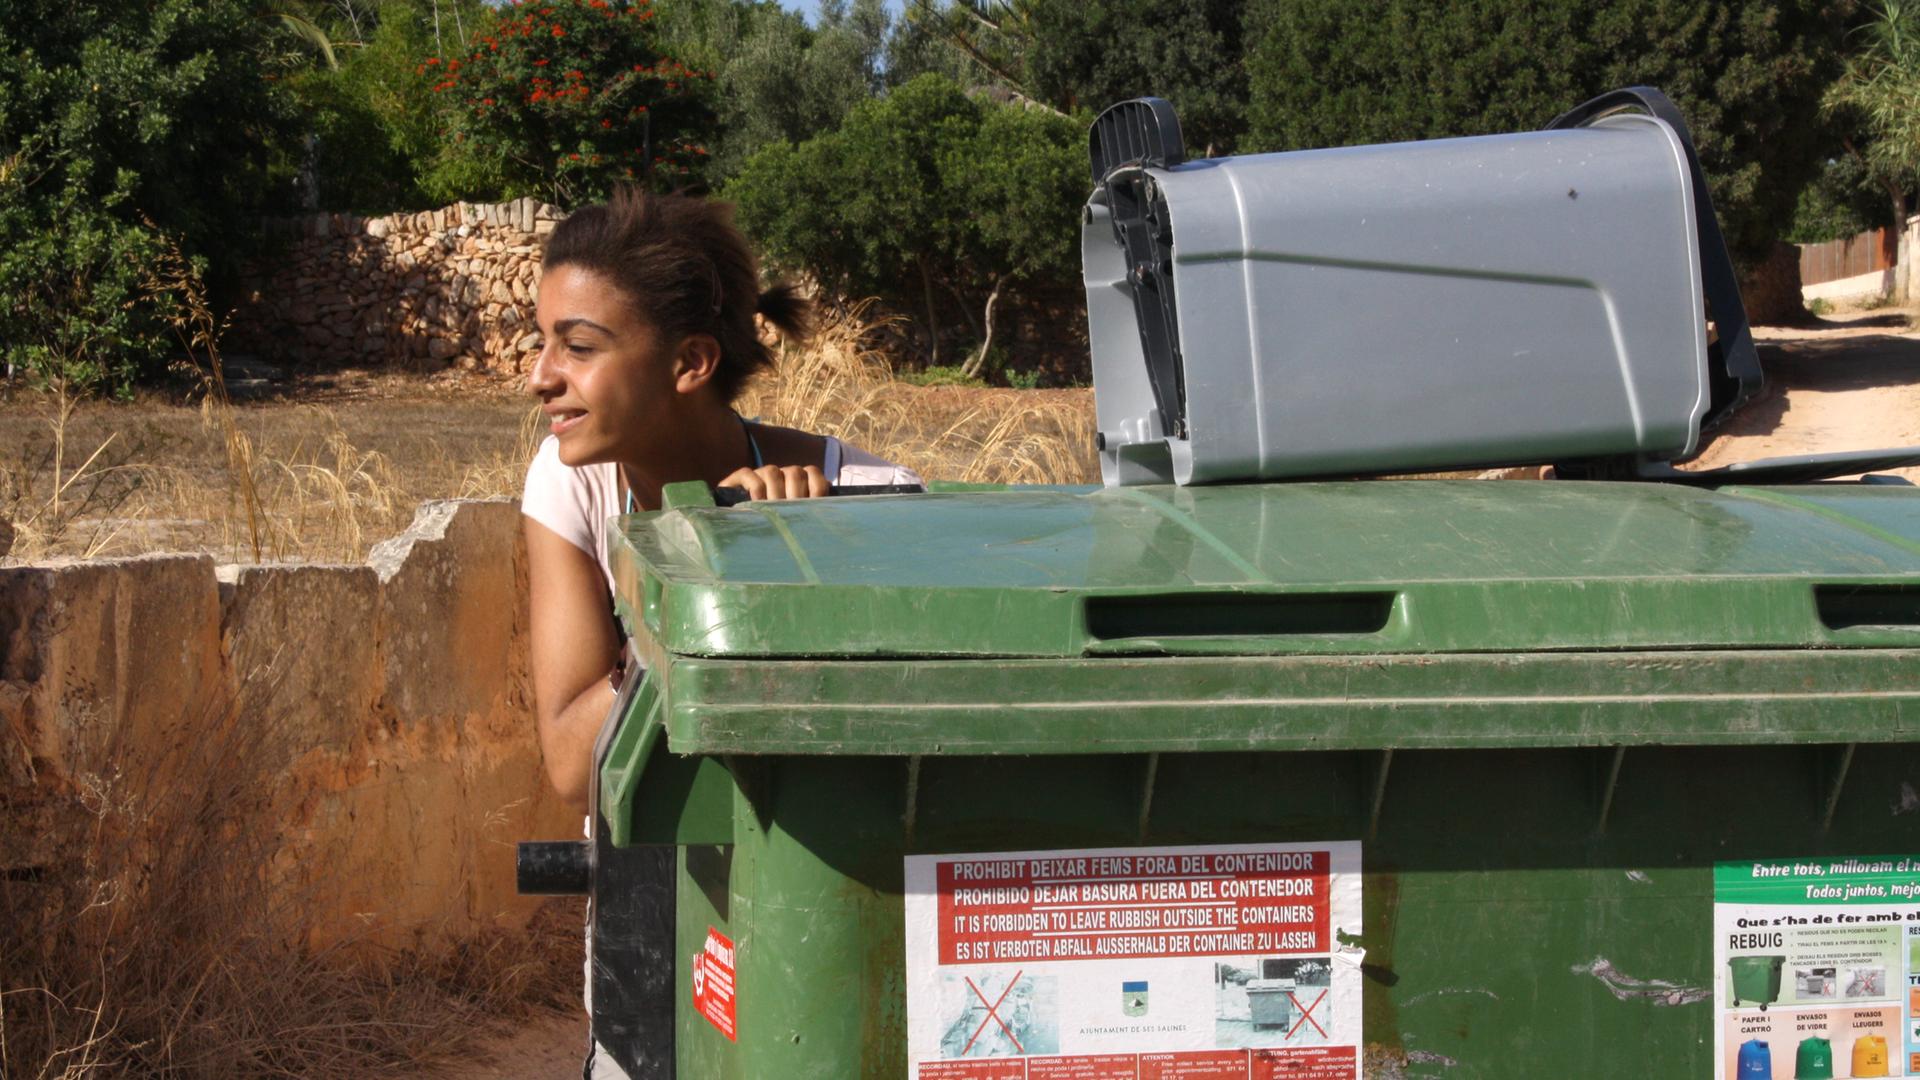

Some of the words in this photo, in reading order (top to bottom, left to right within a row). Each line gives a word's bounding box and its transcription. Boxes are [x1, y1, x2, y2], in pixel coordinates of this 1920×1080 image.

[954, 861, 1026, 880] PROHIBIT
[1031, 858, 1087, 877] DEIXAR
[1092, 857, 1132, 875] FEMS
[1136, 856, 1177, 874] FORA
[1182, 855, 1210, 873] DEL
[1214, 853, 1313, 872] CONTENIDOR
[1752, 863, 1790, 878] Entre
[1794, 862, 1825, 876] tots,
[1830, 860, 1893, 874] milloram
[1896, 858, 1910, 872] el
[954, 886, 1030, 906] PROHIBIDO
[1034, 885, 1078, 903] DEJAR
[1082, 883, 1138, 902] BASURA
[1142, 881, 1187, 900] FUERA
[1191, 880, 1217, 899] DEL
[1220, 878, 1314, 898] CONTENEDOR
[1806, 884, 1842, 899] Todos
[1843, 882, 1888, 901] juntos,
[954, 915, 966, 934] IT
[969, 915, 981, 933] IS
[983, 912, 1049, 932] FORBIDDEN
[1052, 912, 1067, 930] TO
[1070, 911, 1107, 929] LEAVE
[1109, 909, 1160, 928] RUBBISH
[1163, 908, 1213, 926] OUTSIDE
[1216, 907, 1239, 925] THE
[1241, 905, 1315, 925] CONTAINERS
[1737, 917, 1768, 928] Que
[1772, 915, 1808, 926] s'ha
[1812, 914, 1833, 924] de
[1837, 913, 1862, 923] fer
[1866, 911, 1902, 922] amb
[956, 942, 970, 960] ES
[973, 941, 990, 959] IST
[993, 939, 1050, 958] VERBOTEN
[1053, 938, 1093, 956] ABFALL
[1096, 935, 1167, 955] AUSSERHALB
[1170, 935, 1190, 952] DER
[1193, 933, 1255, 952] CONTAINER
[1257, 932, 1272, 950] ZU
[1275, 931, 1316, 950] LASSEN
[1729, 932, 1783, 950] REBUIG
[1741, 1016, 1767, 1024] PAPER
[1796, 1013, 1828, 1022] ENVASOS
[1853, 1011, 1882, 1019] ENVASOS
[1080, 1026, 1129, 1035] AJUNTAMENT
[1740, 1024, 1772, 1034] CARTRÓ
[1796, 1023, 1805, 1031] DE
[1807, 1022, 1828, 1031] VIDRE
[1852, 1020, 1884, 1029] LLEUGERS
